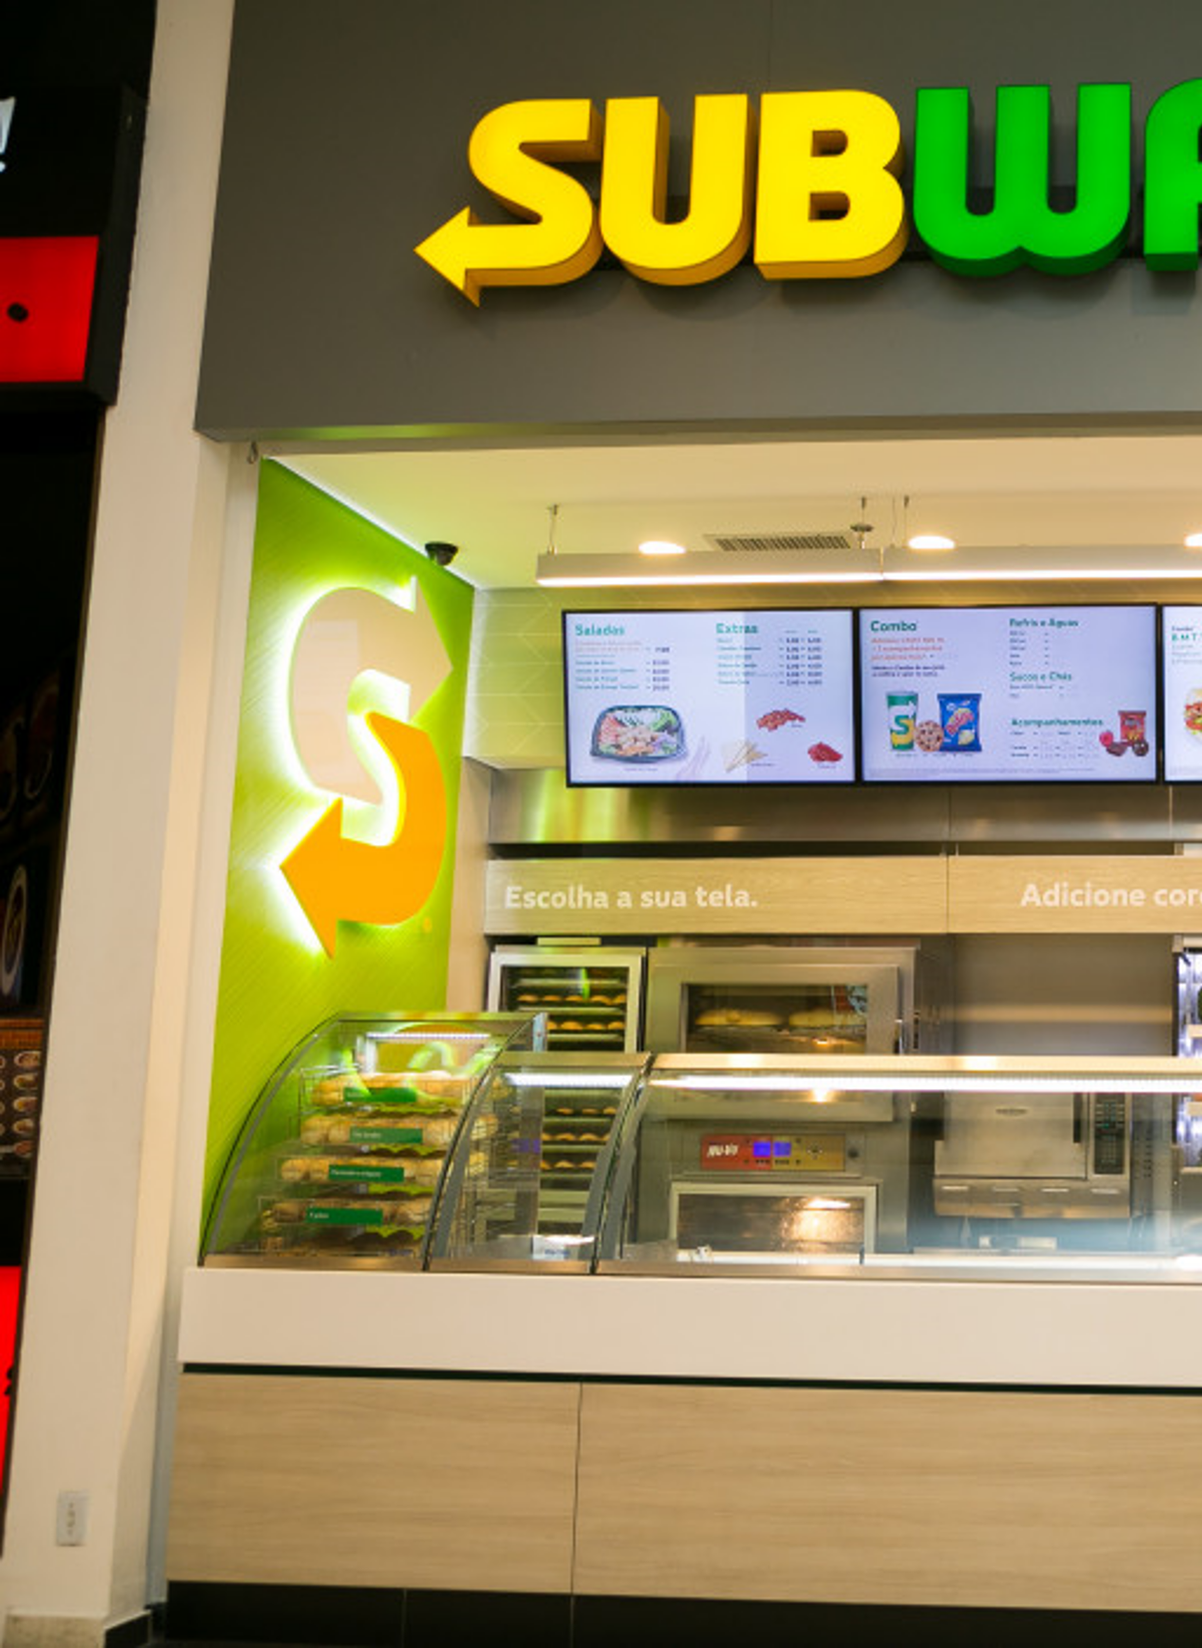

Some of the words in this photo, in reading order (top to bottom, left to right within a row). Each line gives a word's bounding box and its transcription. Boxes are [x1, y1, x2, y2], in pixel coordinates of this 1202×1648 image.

[574, 623, 626, 636] Saladas
[716, 622, 759, 634] Extras
[870, 619, 917, 632] Combo
[503, 884, 609, 909] Escolha
[616, 890, 633, 908] a
[640, 890, 688, 908] sua
[696, 884, 758, 908] tela.
[1020, 882, 1146, 908] Adicione
